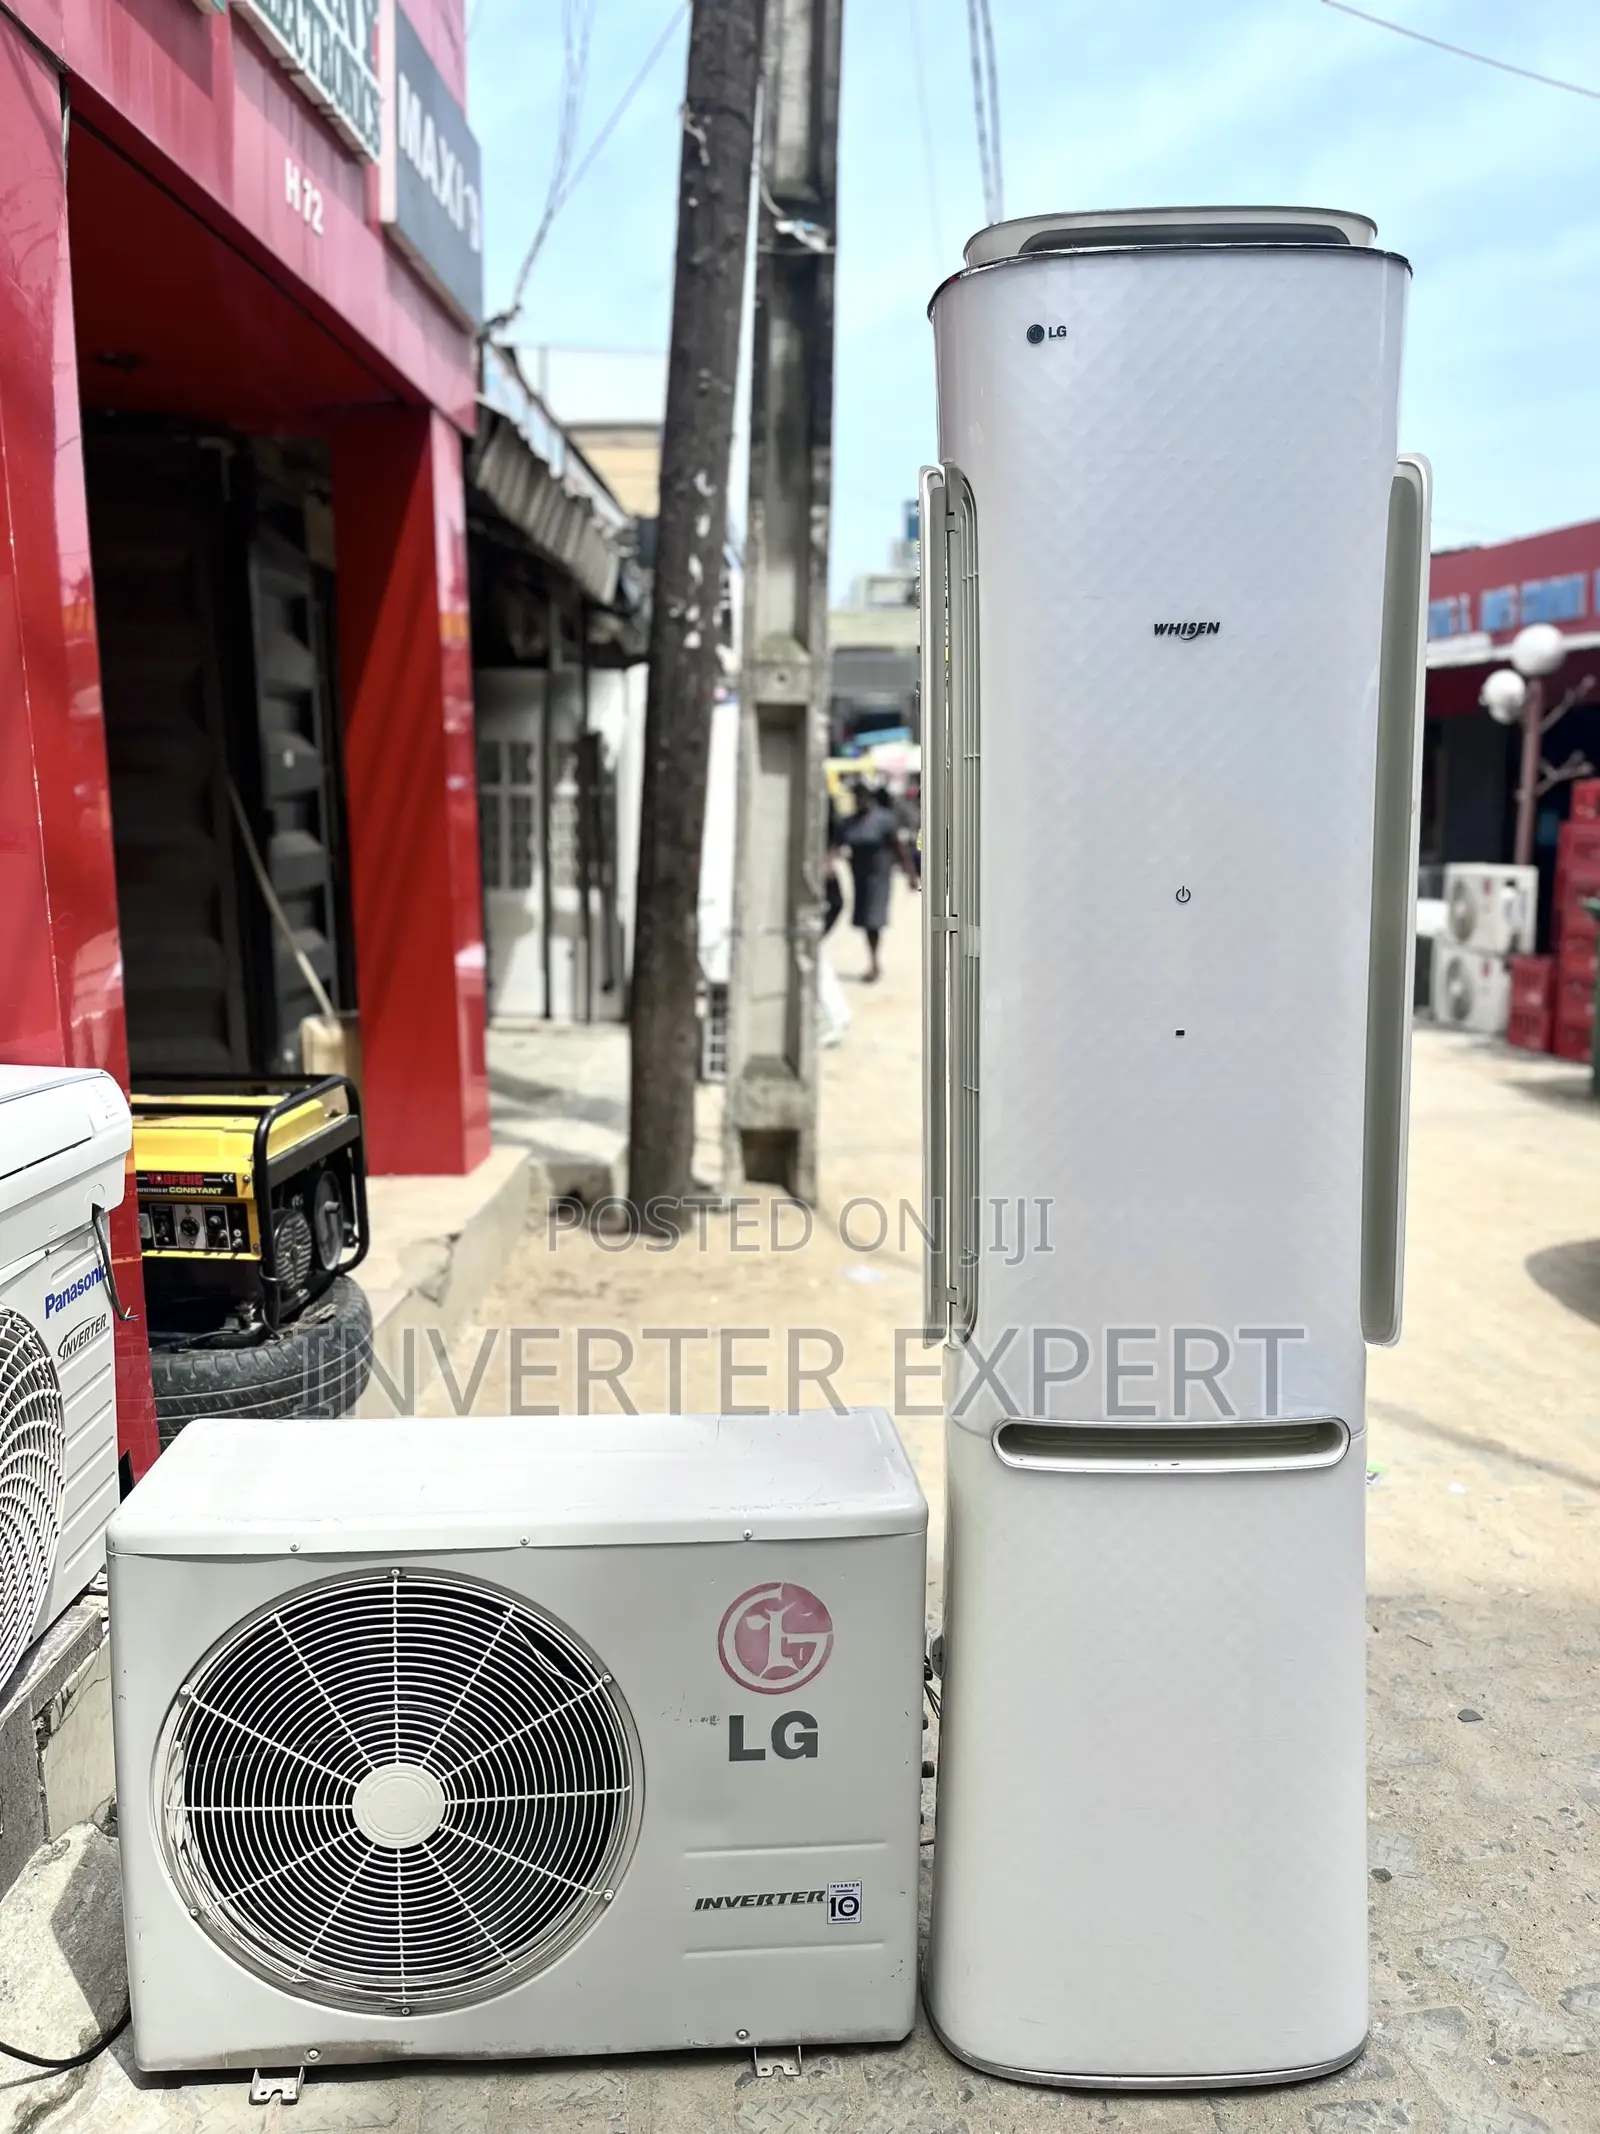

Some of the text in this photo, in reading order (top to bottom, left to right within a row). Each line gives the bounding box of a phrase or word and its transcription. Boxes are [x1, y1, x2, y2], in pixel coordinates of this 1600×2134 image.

[285, 157, 324, 236] H 72
[1048, 325, 1067, 338] LG
[1153, 621, 1221, 640] WHISEN
[169, 1186, 222, 1194] CONSTANT
[61, 1313, 107, 1360] INVERTER
[728, 1710, 819, 1762] LG
[694, 1890, 826, 1910] INVERTER
[830, 1896, 859, 1917] 10
